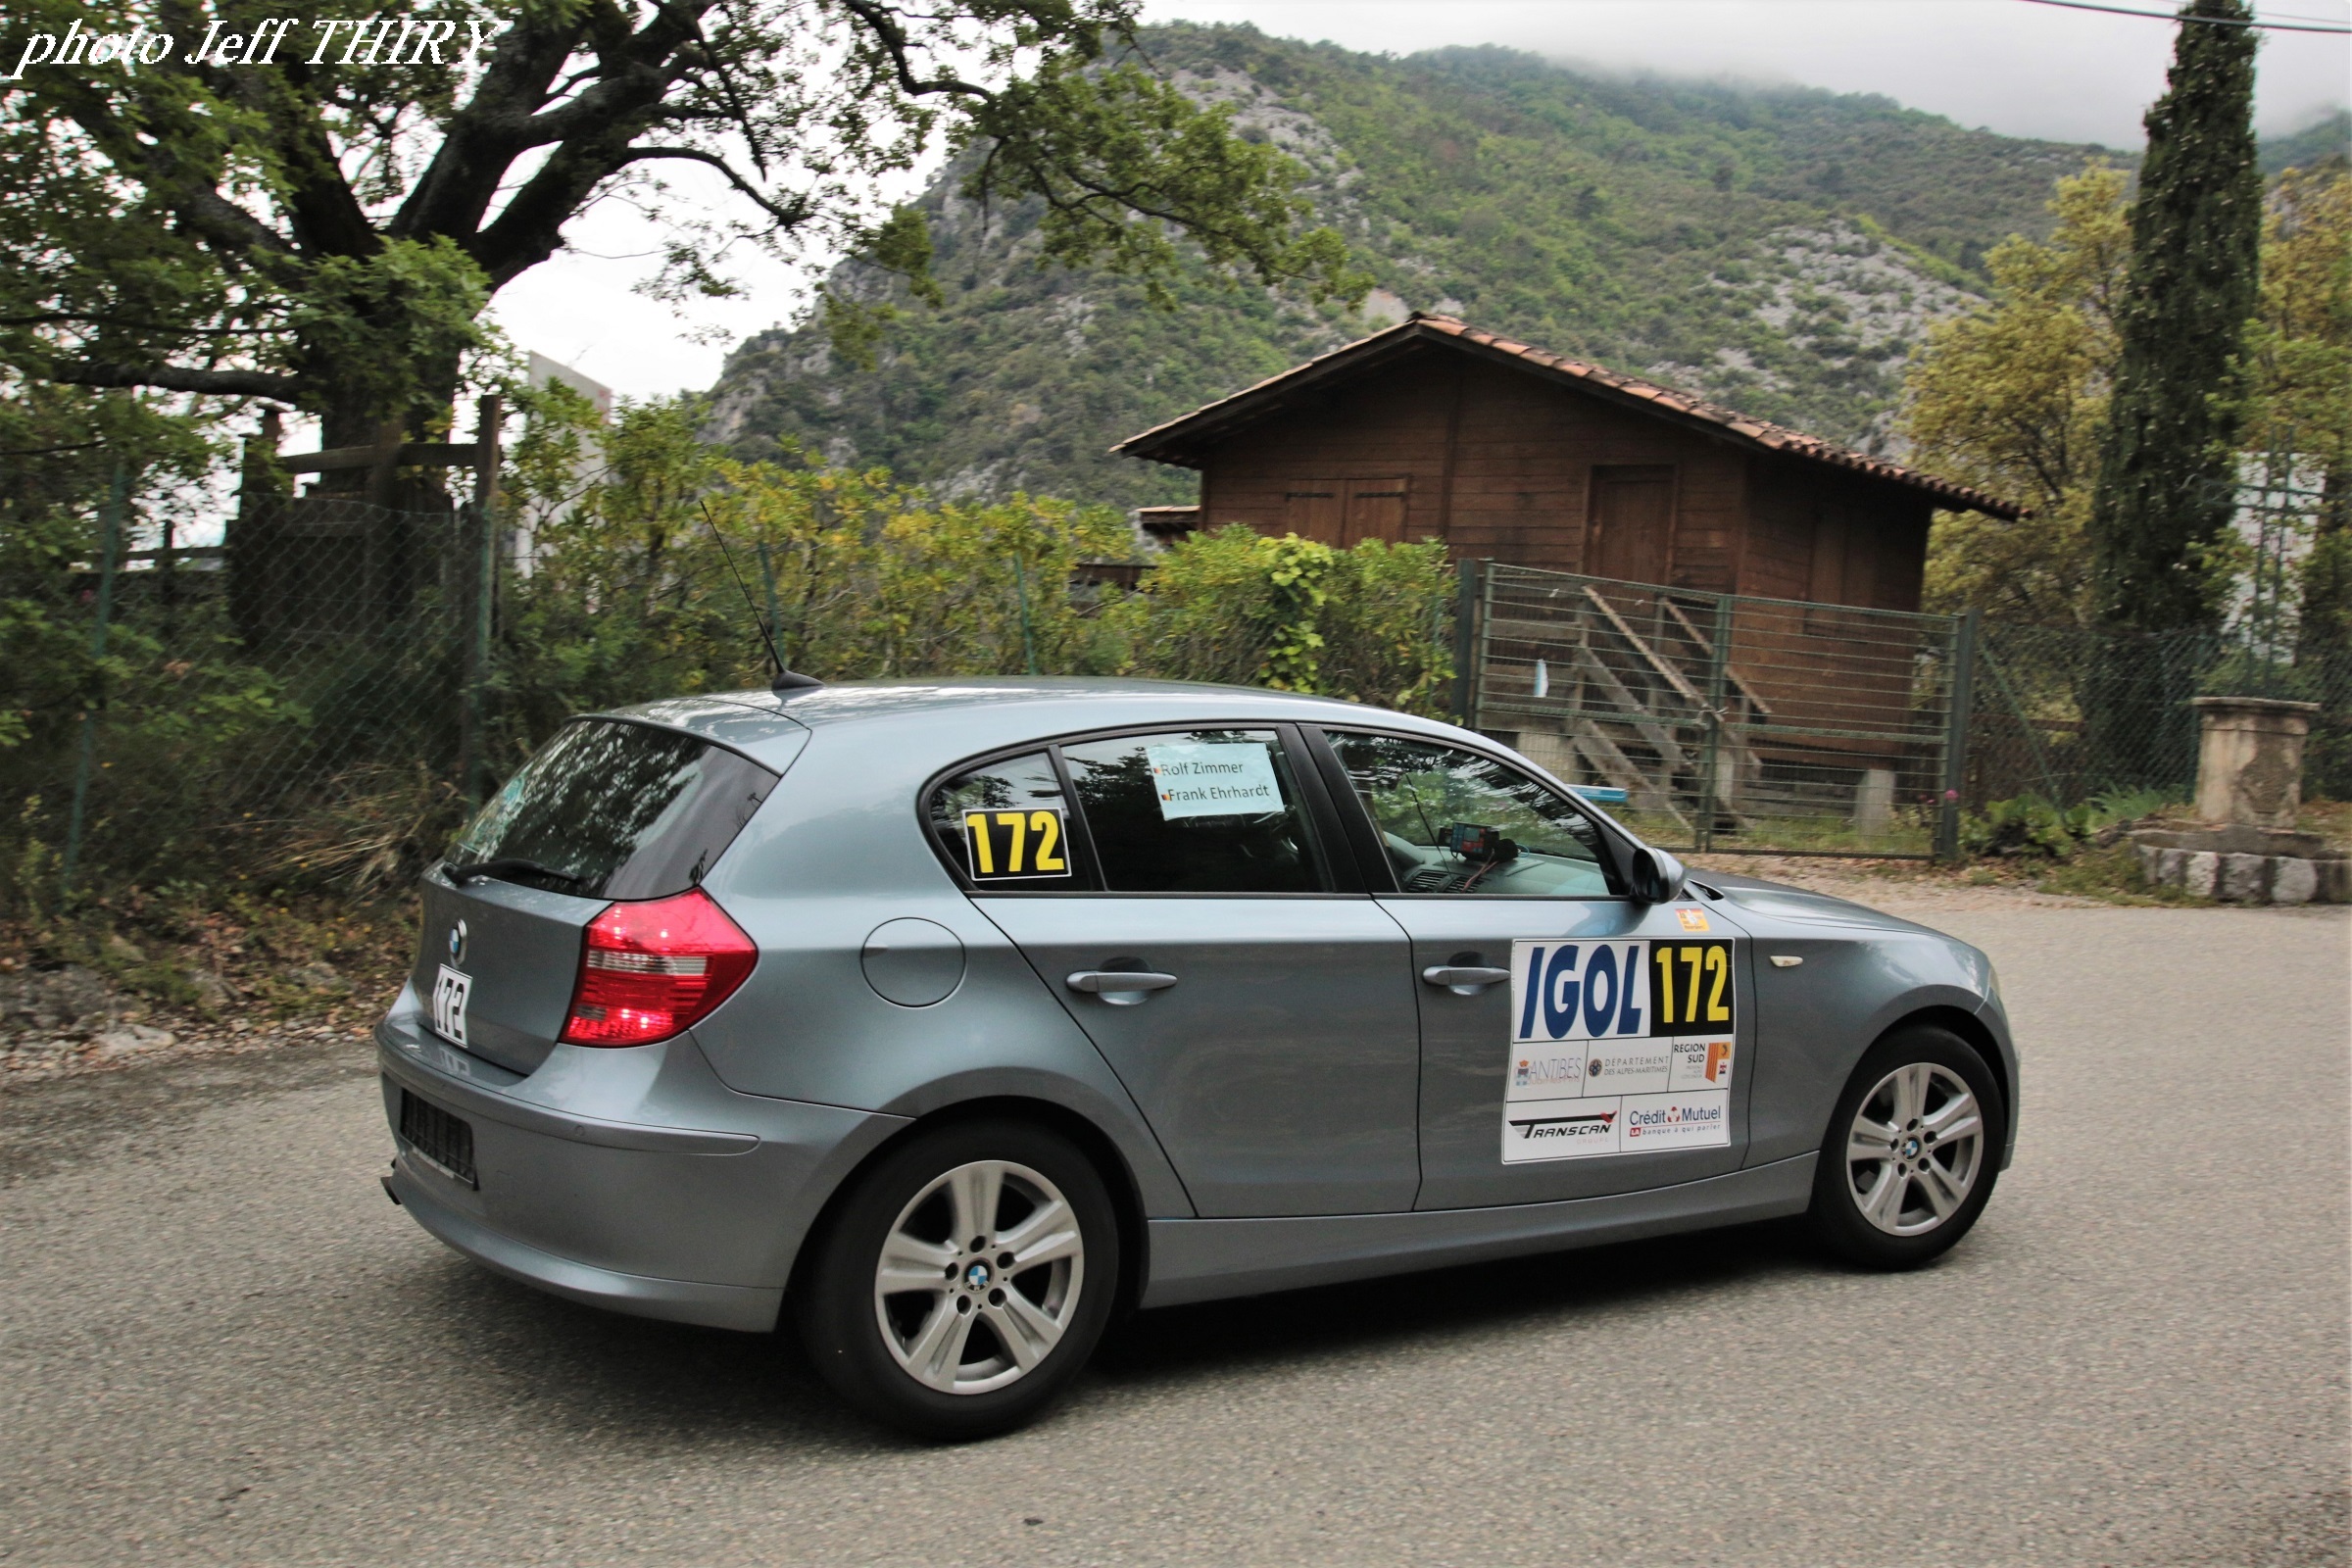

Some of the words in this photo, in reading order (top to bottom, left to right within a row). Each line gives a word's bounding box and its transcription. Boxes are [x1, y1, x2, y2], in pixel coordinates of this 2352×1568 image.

[1160, 762, 1190, 777] Rolf
[1193, 760, 1244, 775] Zimmer
[1168, 786, 1207, 802] Frank
[1210, 783, 1270, 799] Ehrhardt
[966, 810, 1065, 874] 172
[1519, 944, 1642, 1039] IGOL
[1656, 945, 1730, 1023] 172
[1674, 1043, 1706, 1054] REGION
[1604, 1055, 1670, 1067] DÉPARTEMENT
[1687, 1054, 1705, 1063] SUD
[1529, 1057, 1582, 1079] ANTIBES
[1603, 1067, 1615, 1076] DES
[1617, 1065, 1669, 1076] ALPES-MARITIMES
[1629, 1109, 1666, 1125] Crédit
[1682, 1105, 1721, 1121] Mutuel
[1642, 1127, 1671, 1136] banque
[1682, 1125, 1694, 1134] qui
[1696, 1123, 1721, 1133] parler
